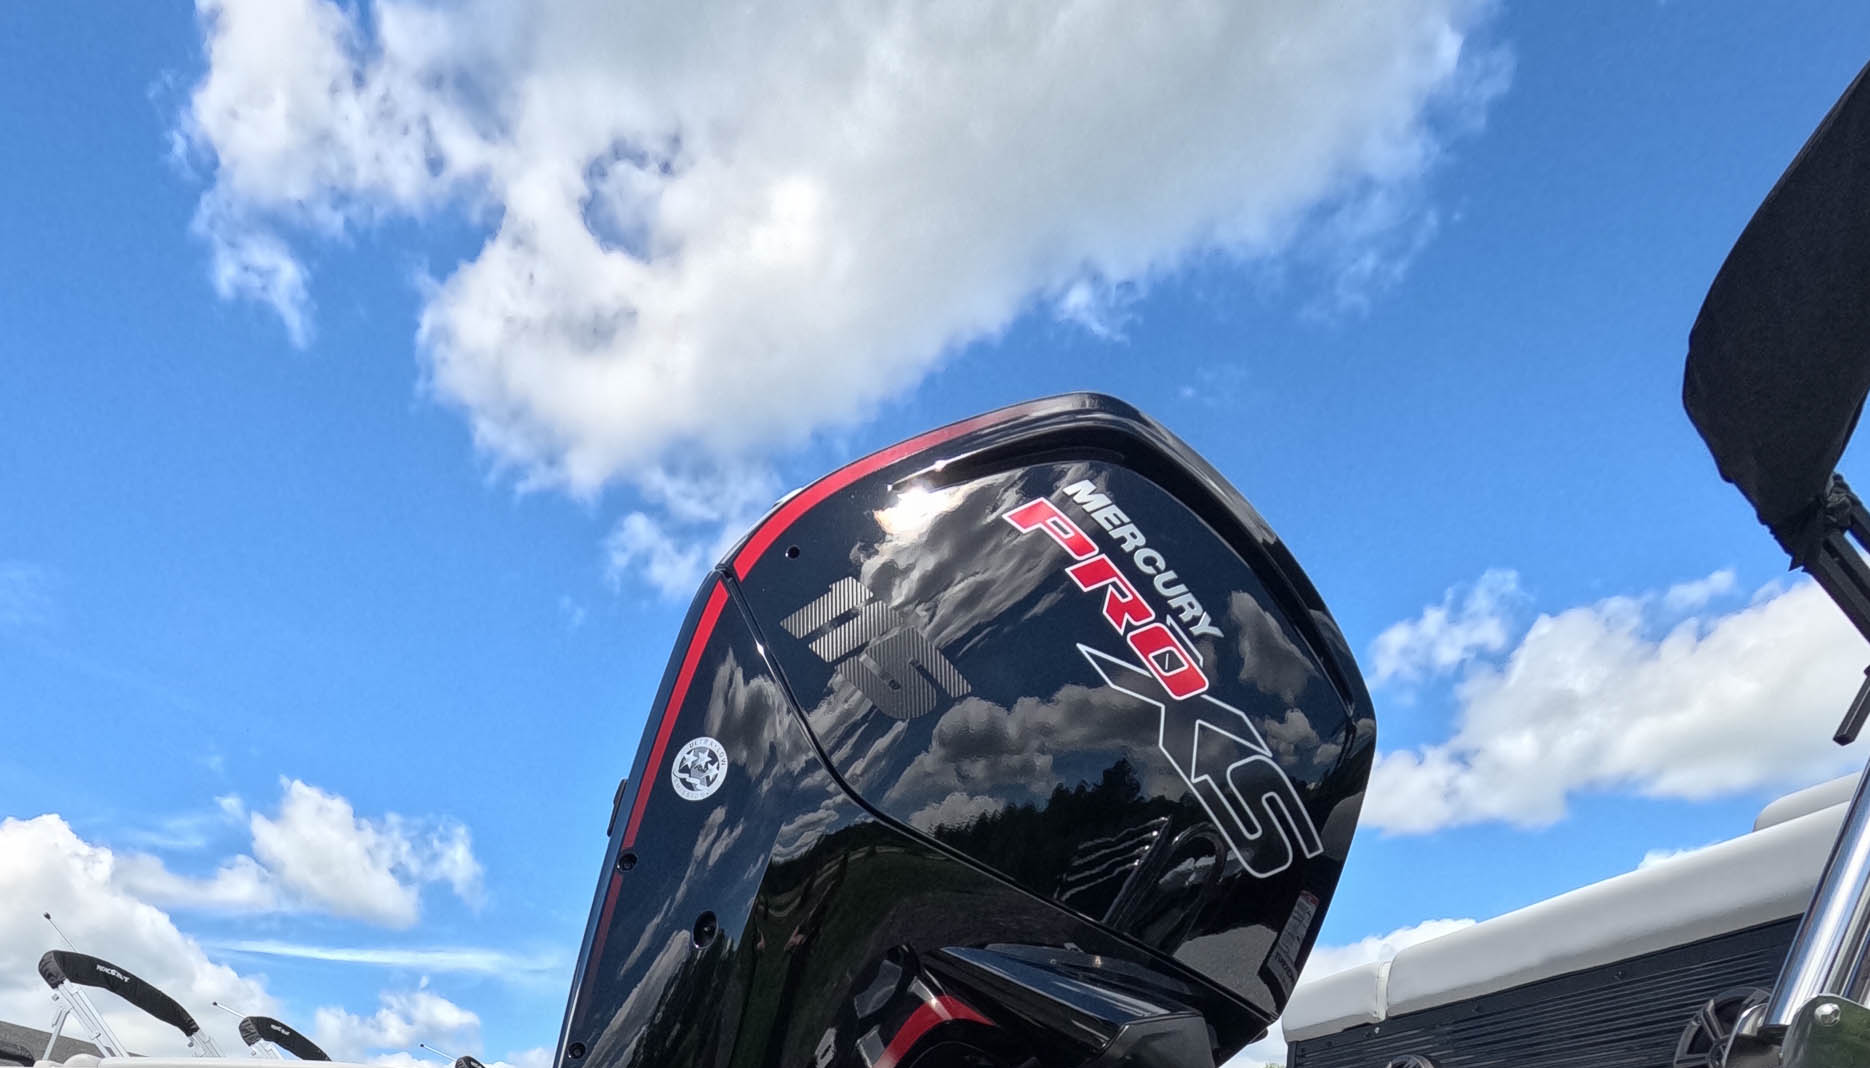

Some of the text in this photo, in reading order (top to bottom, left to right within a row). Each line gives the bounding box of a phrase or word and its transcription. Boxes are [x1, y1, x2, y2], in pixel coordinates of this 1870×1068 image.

[1002, 497, 1209, 700] PRO
[1063, 479, 1224, 639] MERCURY
[1076, 614, 1324, 878] XS
